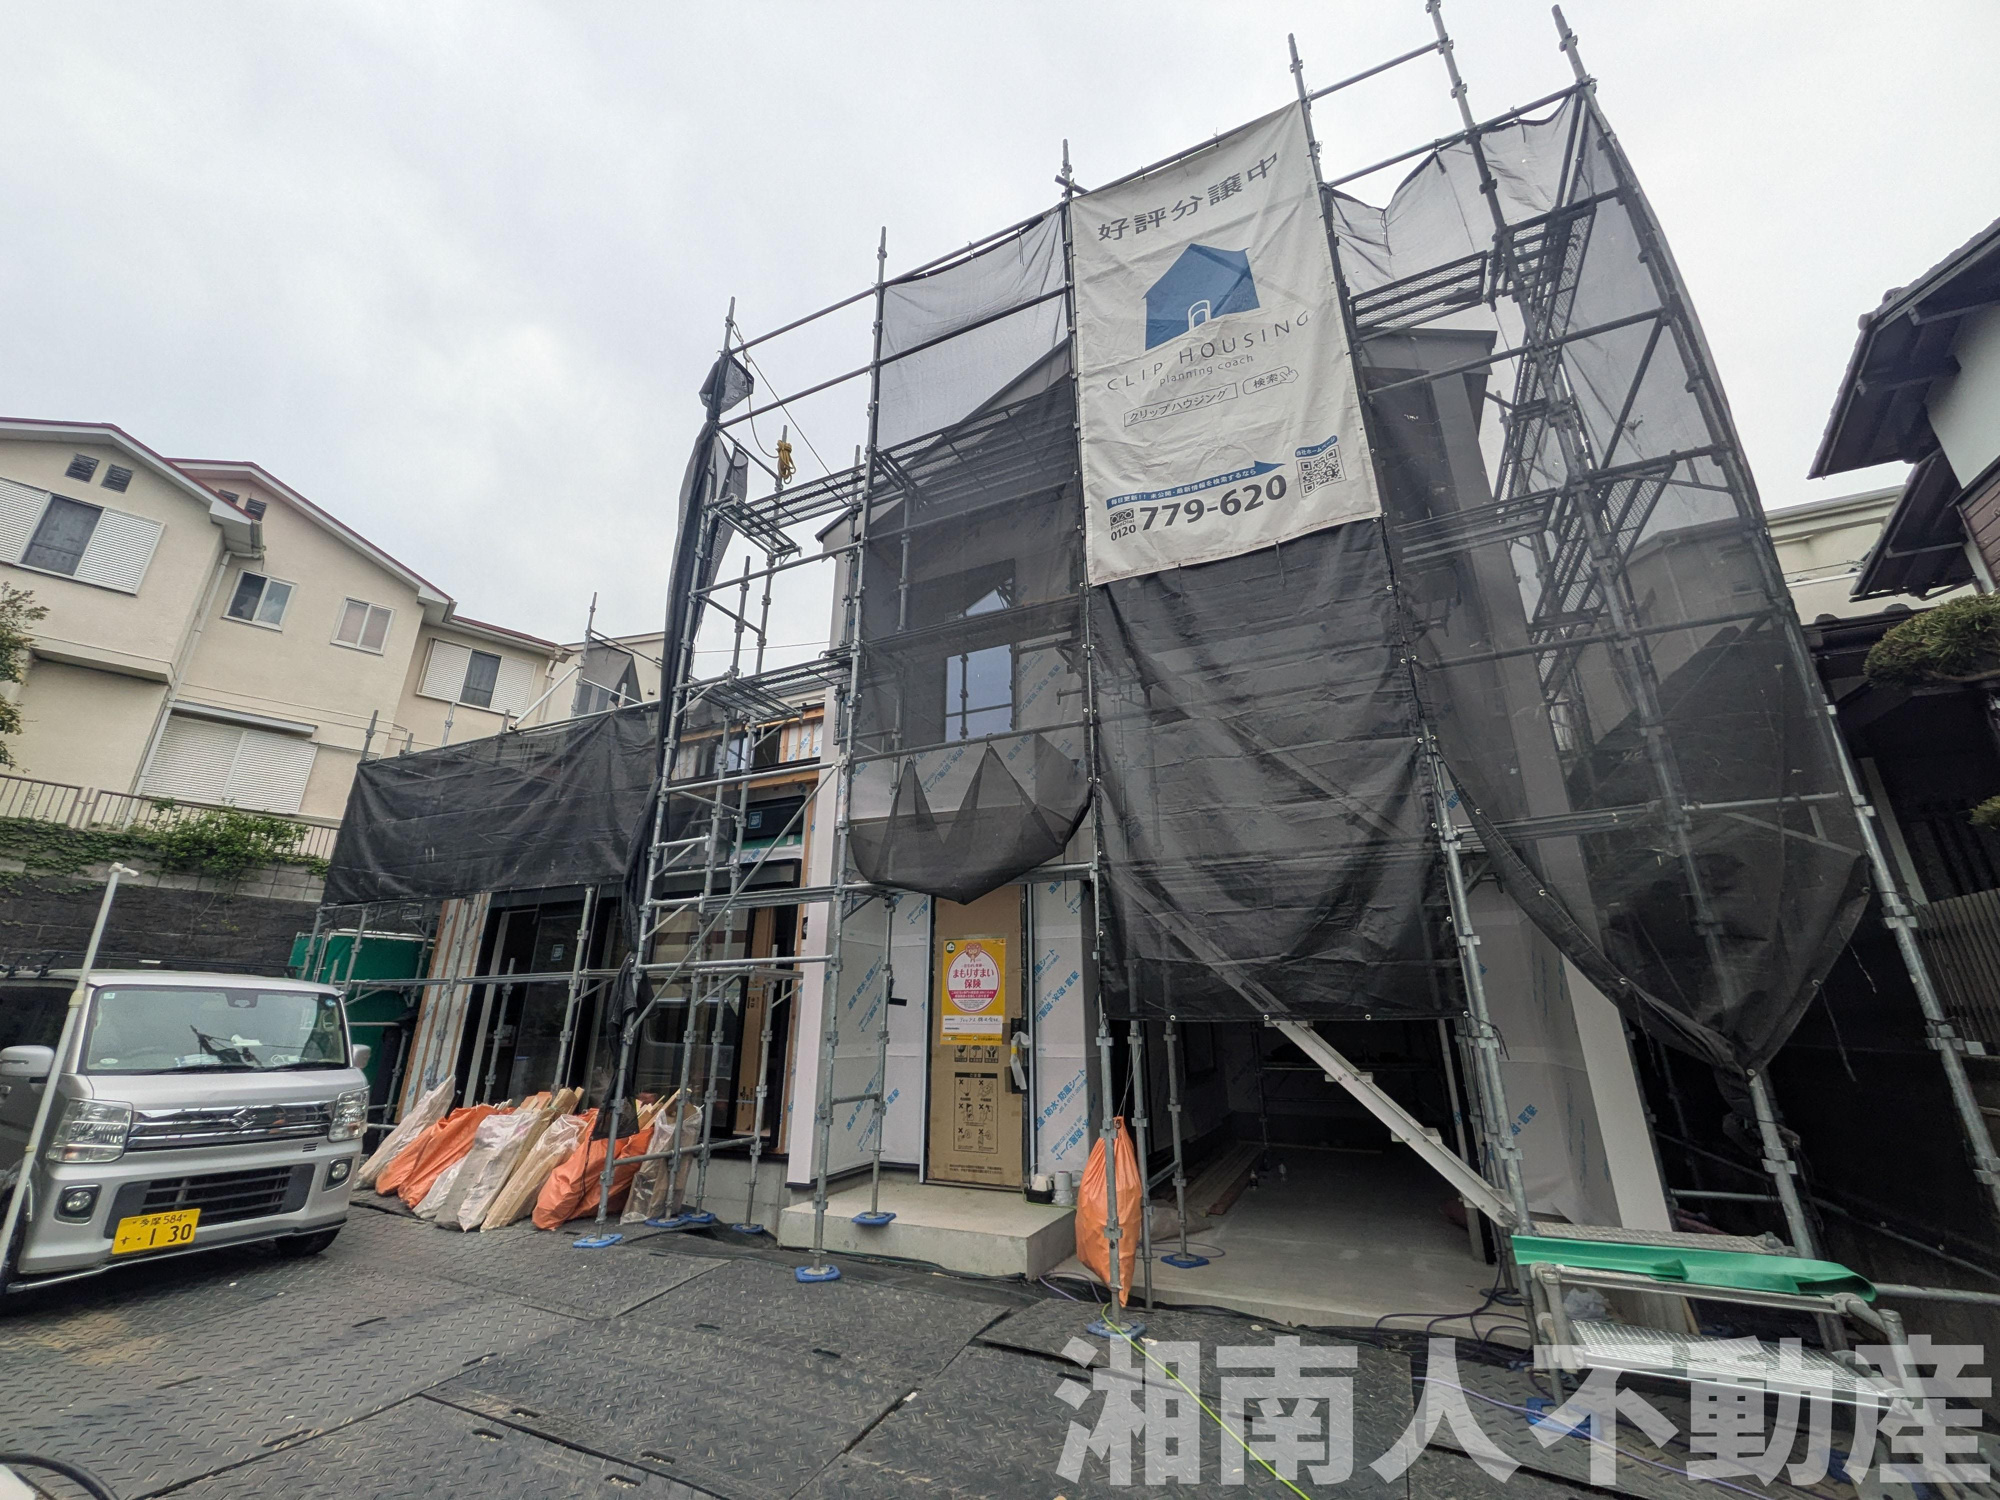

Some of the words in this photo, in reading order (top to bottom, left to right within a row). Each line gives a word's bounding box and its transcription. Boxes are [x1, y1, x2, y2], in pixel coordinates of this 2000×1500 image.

[1098, 152, 1278, 241] 好評分譲中
[1107, 362, 1163, 391] CLIP
[1179, 310, 1309, 364] HOUSING
[1159, 365, 1213, 387] planning
[1217, 354, 1254, 371] coach
[1253, 374, 1279, 389] 検索
[1129, 387, 1228, 422] クリップハウジング
[1110, 524, 1137, 541] 0120
[1139, 474, 1287, 531] 779-620
[952, 968, 995, 978] まもりすまい
[964, 979, 981, 989] 保険
[140, 1217, 162, 1228] 多摩
[163, 1213, 183, 1224] 584
